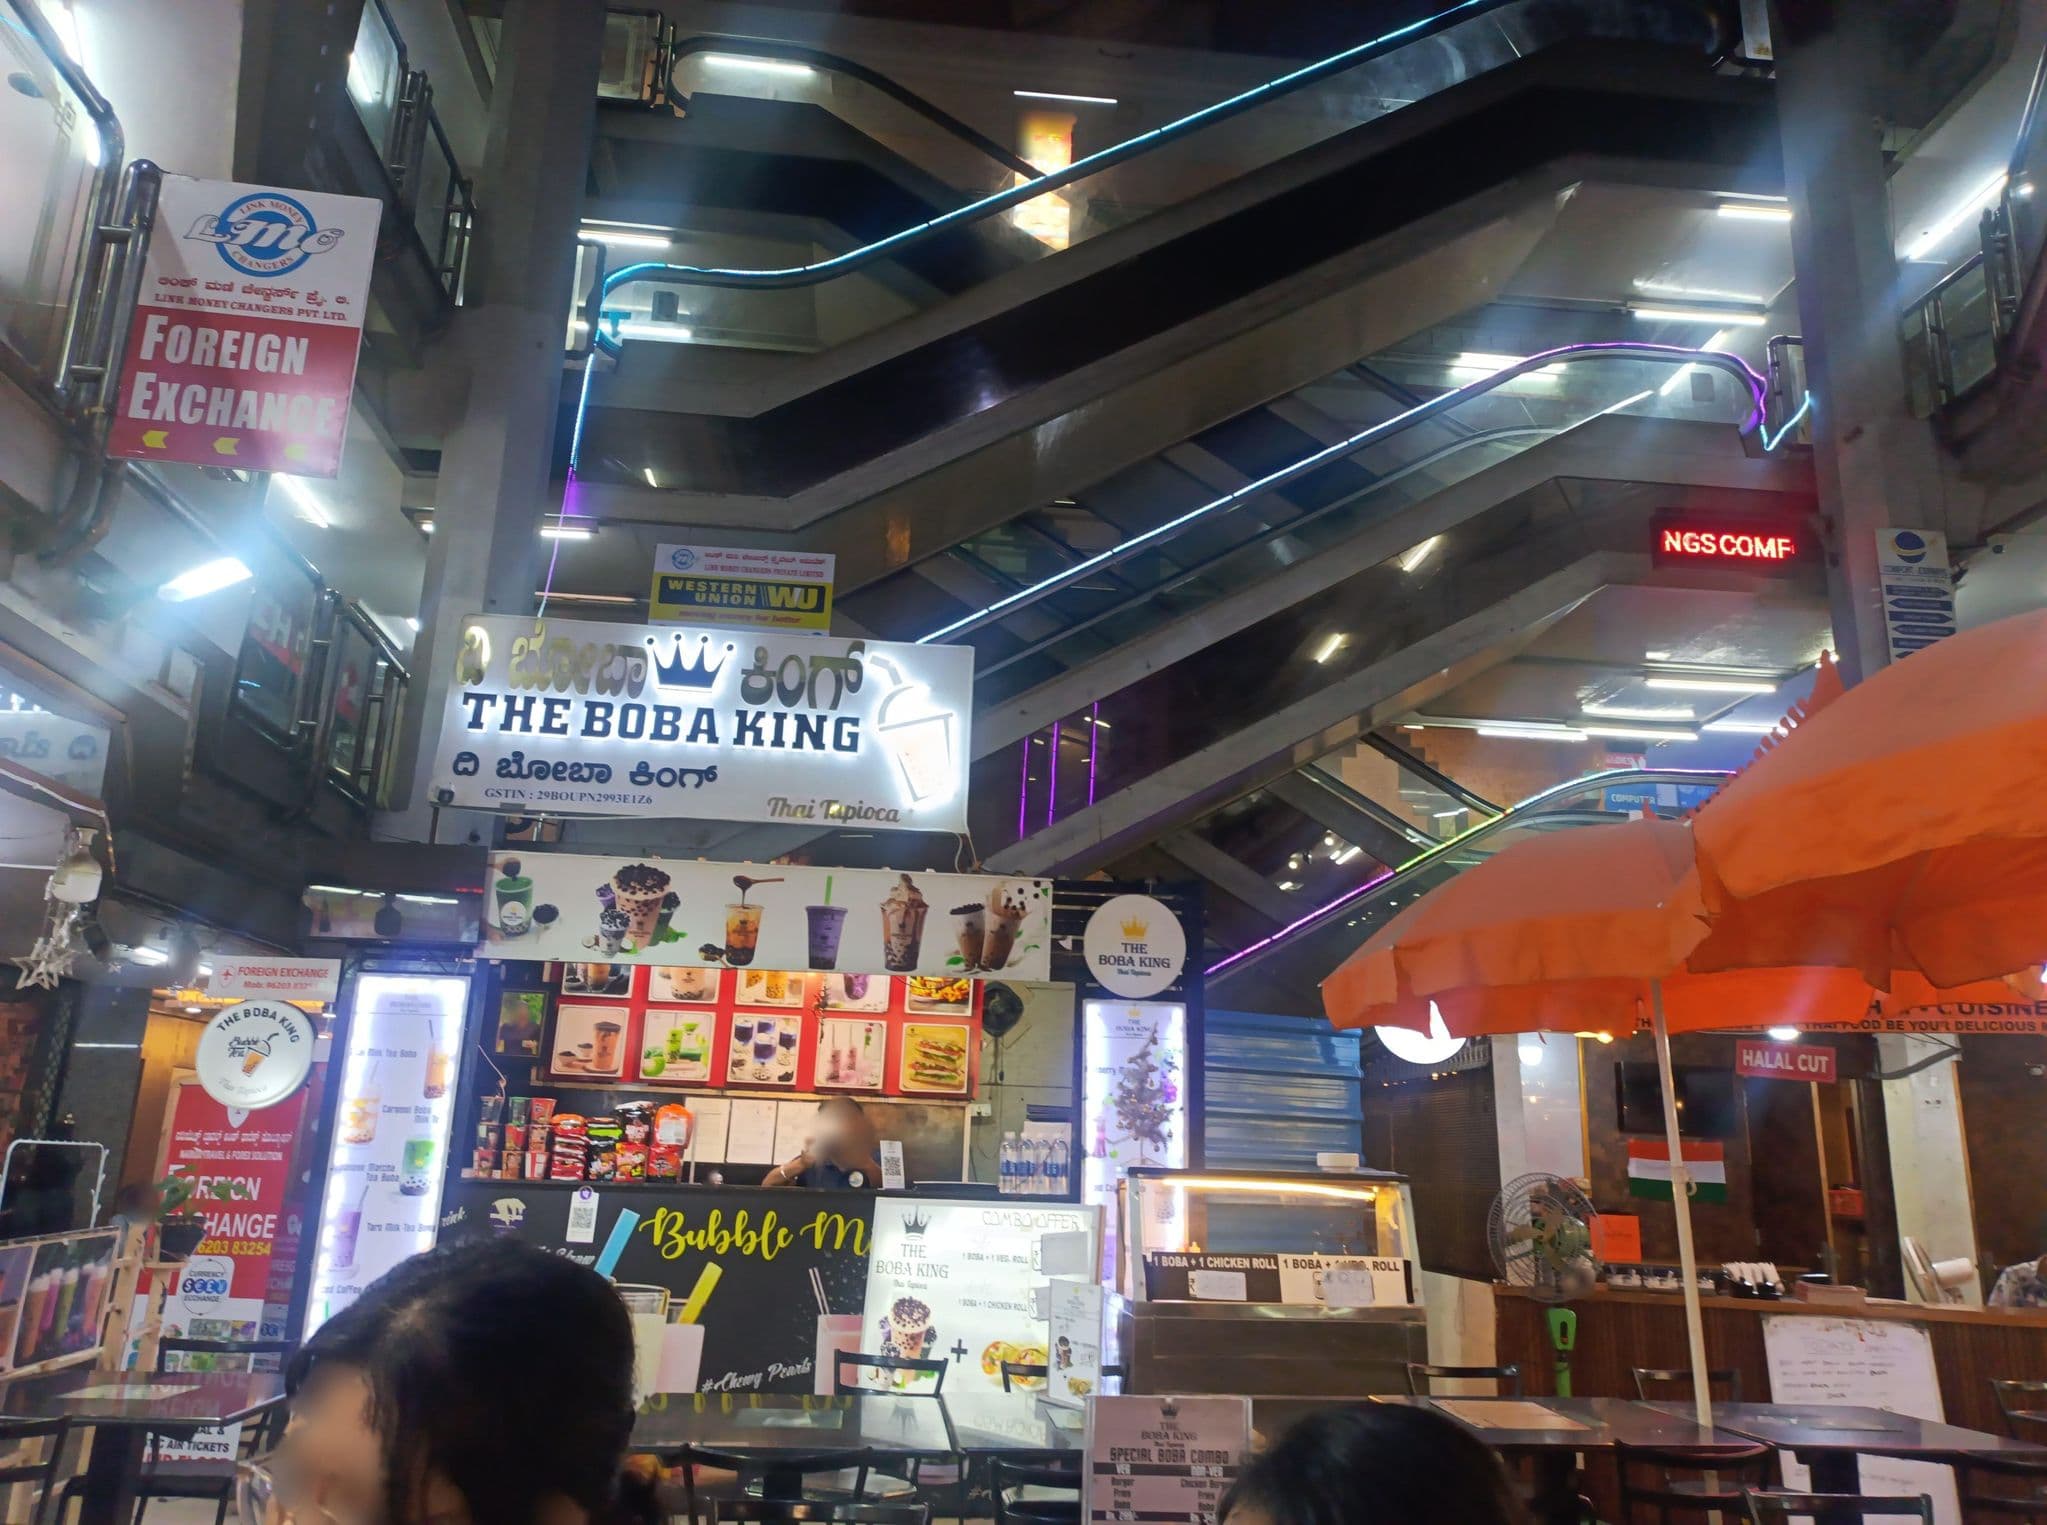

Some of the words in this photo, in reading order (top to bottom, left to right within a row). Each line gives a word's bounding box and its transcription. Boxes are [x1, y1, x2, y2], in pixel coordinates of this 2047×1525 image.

[240, 201, 266, 215] LINK
[270, 200, 304, 223] MONEY
[231, 249, 295, 270] CHANGERS
[154, 292, 184, 305] LINK
[187, 296, 229, 310] MONEY
[230, 301, 294, 316] CHANGERS
[139, 314, 310, 376] FOREIGN
[128, 371, 336, 438] EXCHANGE
[1664, 530, 1717, 554] NGS
[668, 580, 757, 595] WESTERN
[695, 592, 757, 606] UNION
[767, 586, 819, 610] WU
[462, 691, 571, 736] THE
[580, 700, 719, 744] BOBA
[733, 709, 860, 753] KING
[452, 751, 480, 777] ದಿ
[495, 750, 612, 784] ಬೋಬಾ
[629, 760, 718, 788] ಕಿಂಗ್
[484, 788, 526, 800] GSTIN
[767, 797, 816, 820] Thai
[820, 799, 900, 824] Tapioca
[1121, 942, 1148, 954] THE
[1099, 955, 1136, 967] BOBA
[1139, 956, 1171, 968] KING
[238, 967, 278, 976] FOREIGN
[280, 968, 328, 978] EXCHANGE
[217, 1012, 241, 1032] THE
[243, 1007, 277, 1020] BOBA
[279, 1016, 301, 1043] KING
[1886, 1020, 1904, 1030] BE
[1955, 1020, 2036, 1031] DELICIOUS
[1742, 1049, 1794, 1070] HALAL
[1797, 1054, 1829, 1073] CUT
[168, 1164, 262, 1200] REGN
[983, 1210, 1033, 1228] COMBO
[1035, 1212, 1080, 1232] OFFER
[639, 1207, 794, 1260] Bubble
[800, 1211, 873, 1257] M
[198, 1240, 229, 1255] 6203
[232, 1240, 272, 1256] 83254
[901, 1243, 927, 1258] THE
[876, 1260, 912, 1276] BOBA
[916, 1263, 949, 1279] KING
[1162, 1257, 1188, 1268] BOBA
[1206, 1257, 1250, 1270] CHICKEN
[1252, 1258, 1278, 1271] ROLL
[1292, 1259, 1322, 1270] BOBA
[1372, 1260, 1400, 1271] ROLL
[768, 1357, 812, 1382] Pearls
[1141, 1431, 1169, 1440] BOBA
[1173, 1431, 1198, 1441] KING
[167, 1440, 183, 1450] AIR
[186, 1441, 230, 1453] TICKETS
[1110, 1447, 1153, 1463] SPECIAL
[1158, 1448, 1186, 1463] BOBA
[1191, 1450, 1230, 1465] COMBO
